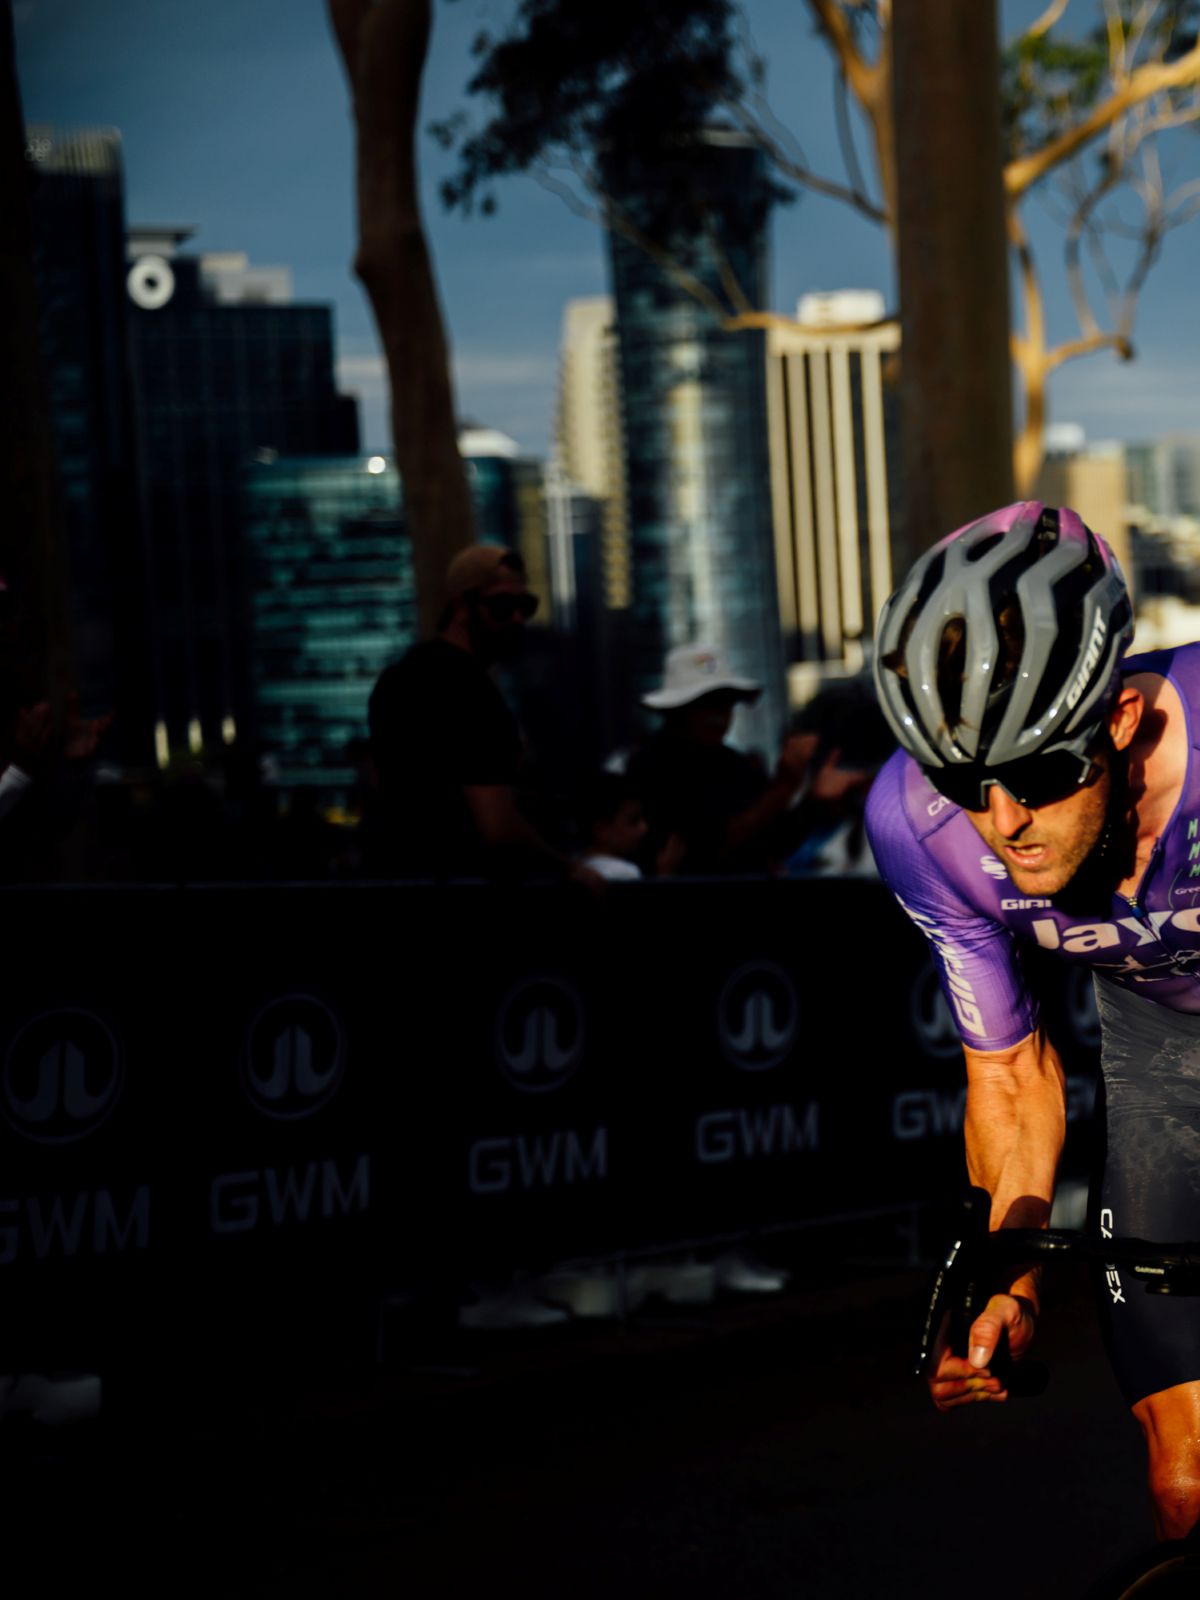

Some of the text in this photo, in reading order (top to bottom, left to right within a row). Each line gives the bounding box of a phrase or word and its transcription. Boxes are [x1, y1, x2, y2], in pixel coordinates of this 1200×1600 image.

[1066, 606, 1106, 710] GIANT
[467, 1123, 607, 1197] GWM
[694, 1099, 820, 1165] GWM
[209, 1153, 371, 1234] GWM
